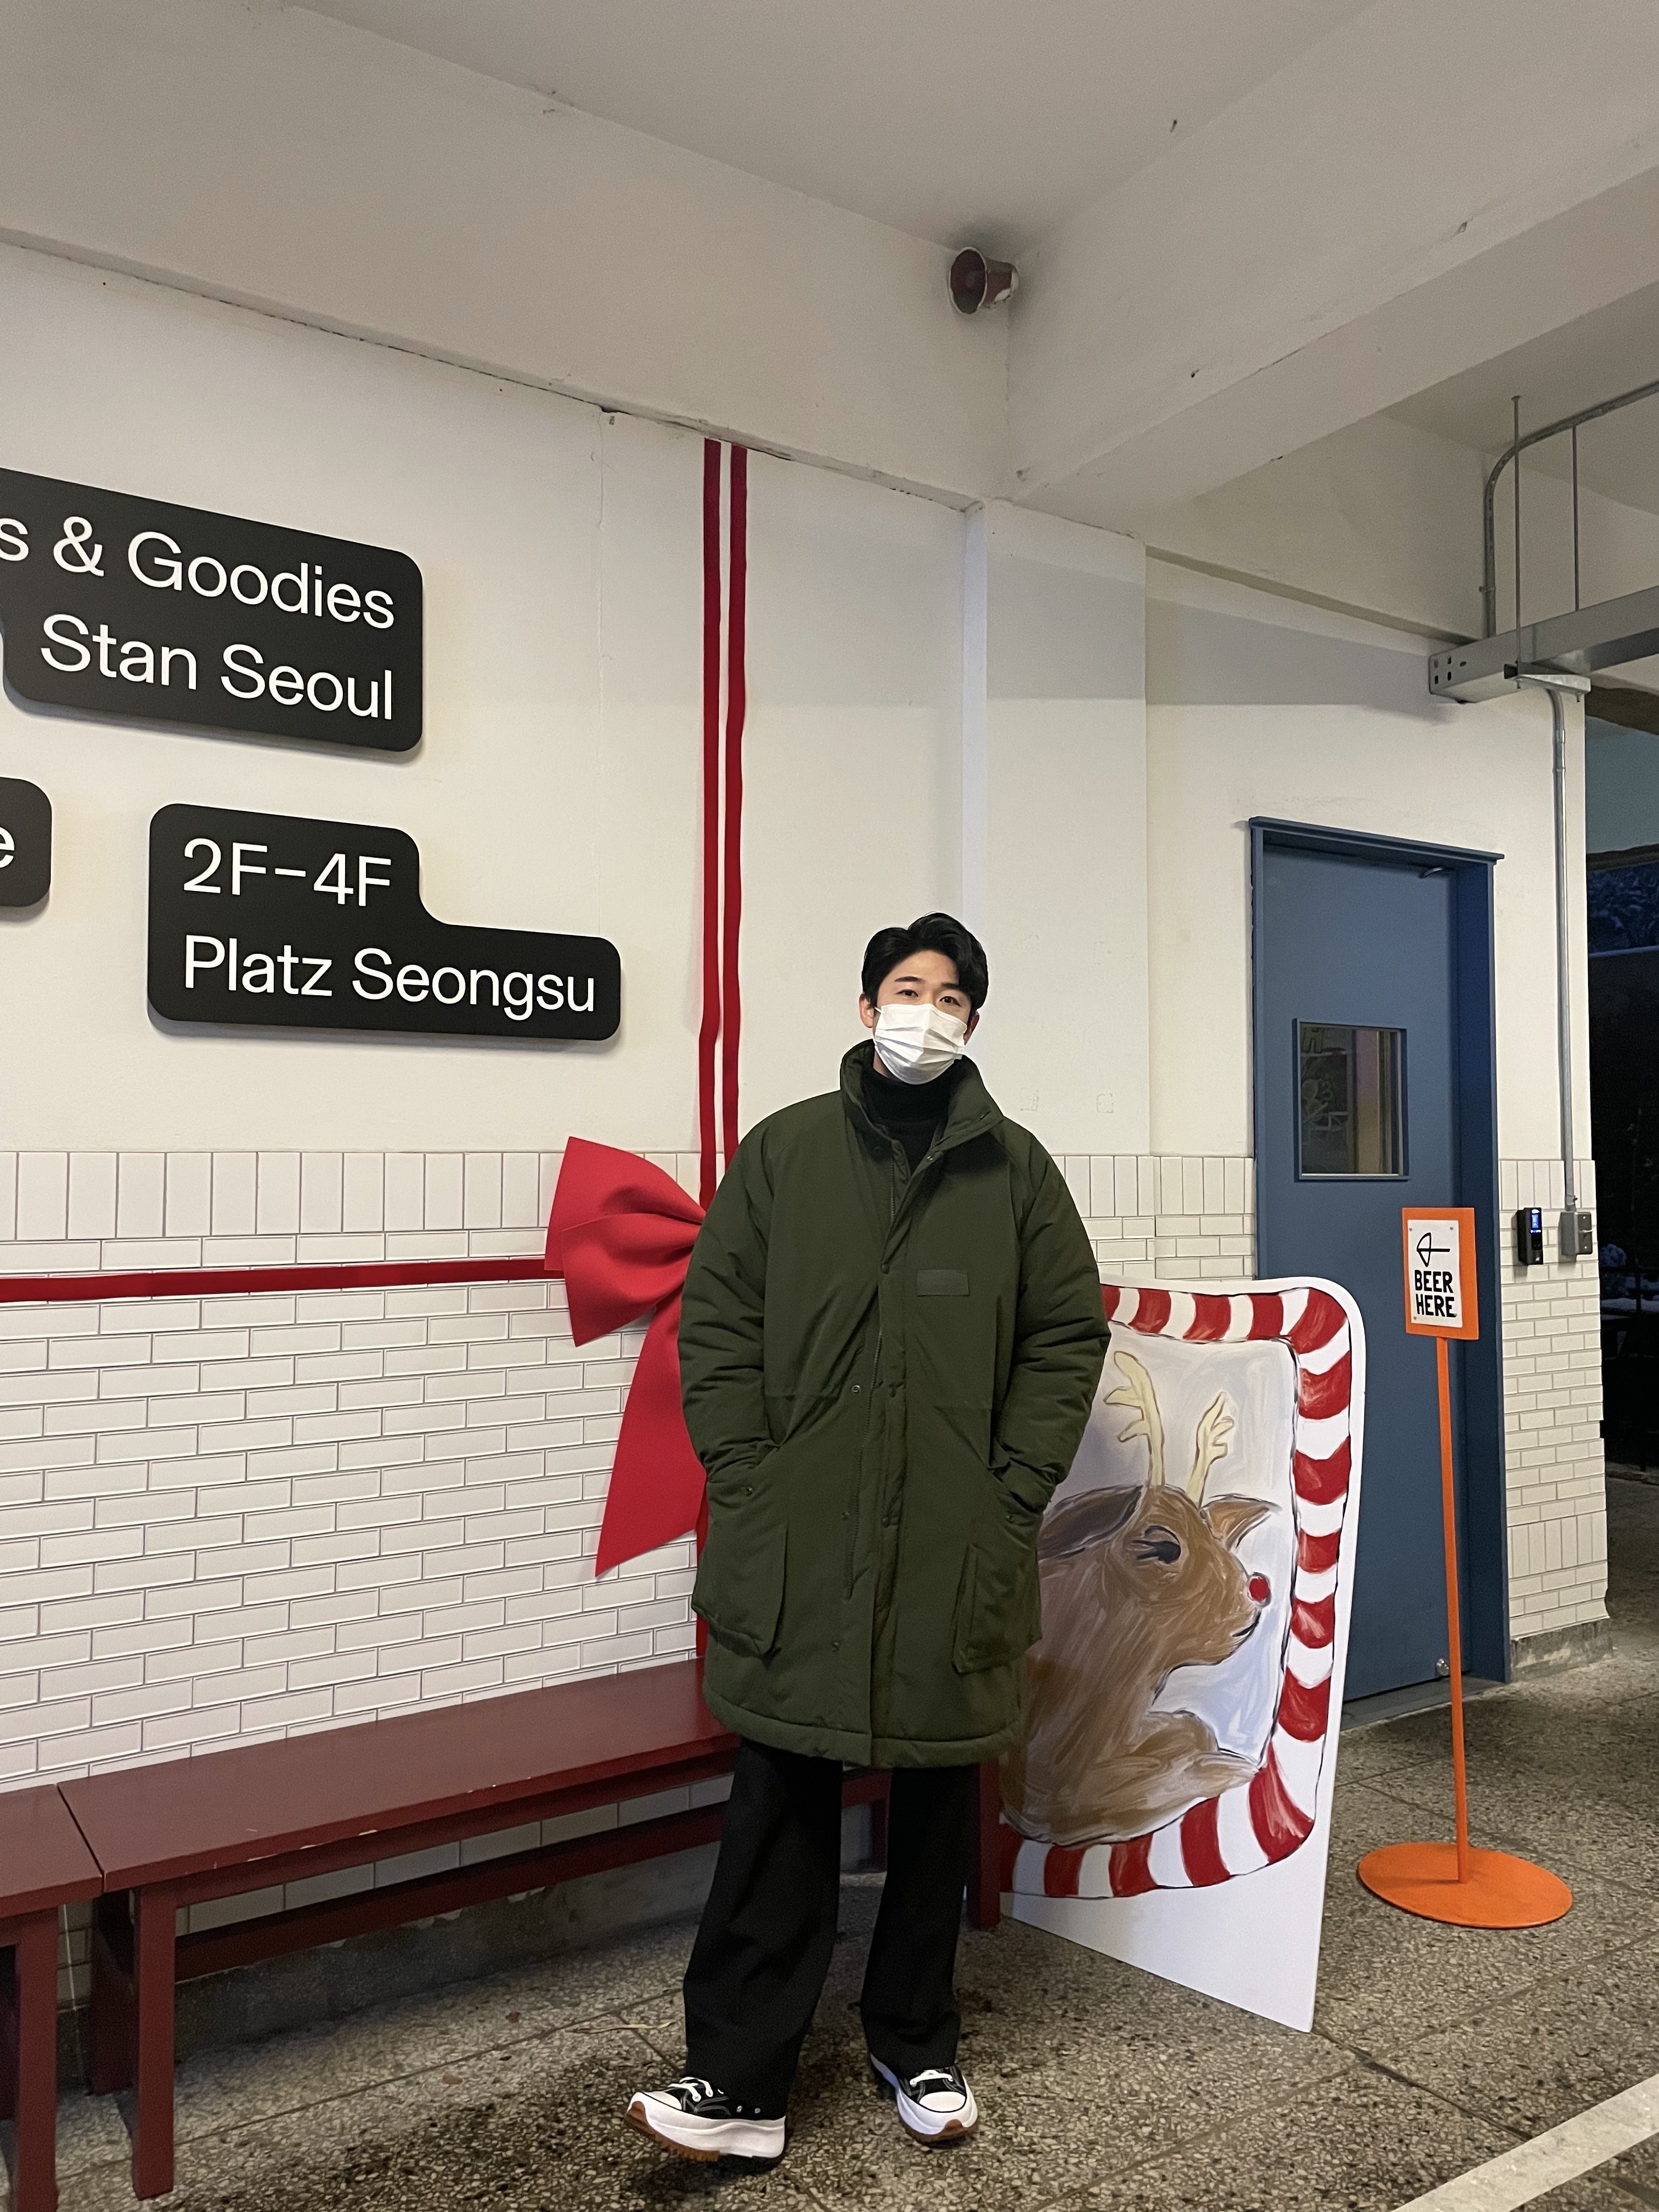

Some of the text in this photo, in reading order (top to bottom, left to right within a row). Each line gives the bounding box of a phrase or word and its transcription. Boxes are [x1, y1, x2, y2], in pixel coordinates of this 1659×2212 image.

[53, 516, 104, 577] &
[128, 531, 394, 629] Goodies
[41, 614, 392, 720] Stan Seoul
[185, 934, 594, 1021] Platz Seongsu
[1414, 1269, 1454, 1294] BEER
[1415, 1294, 1457, 1318] HERE
